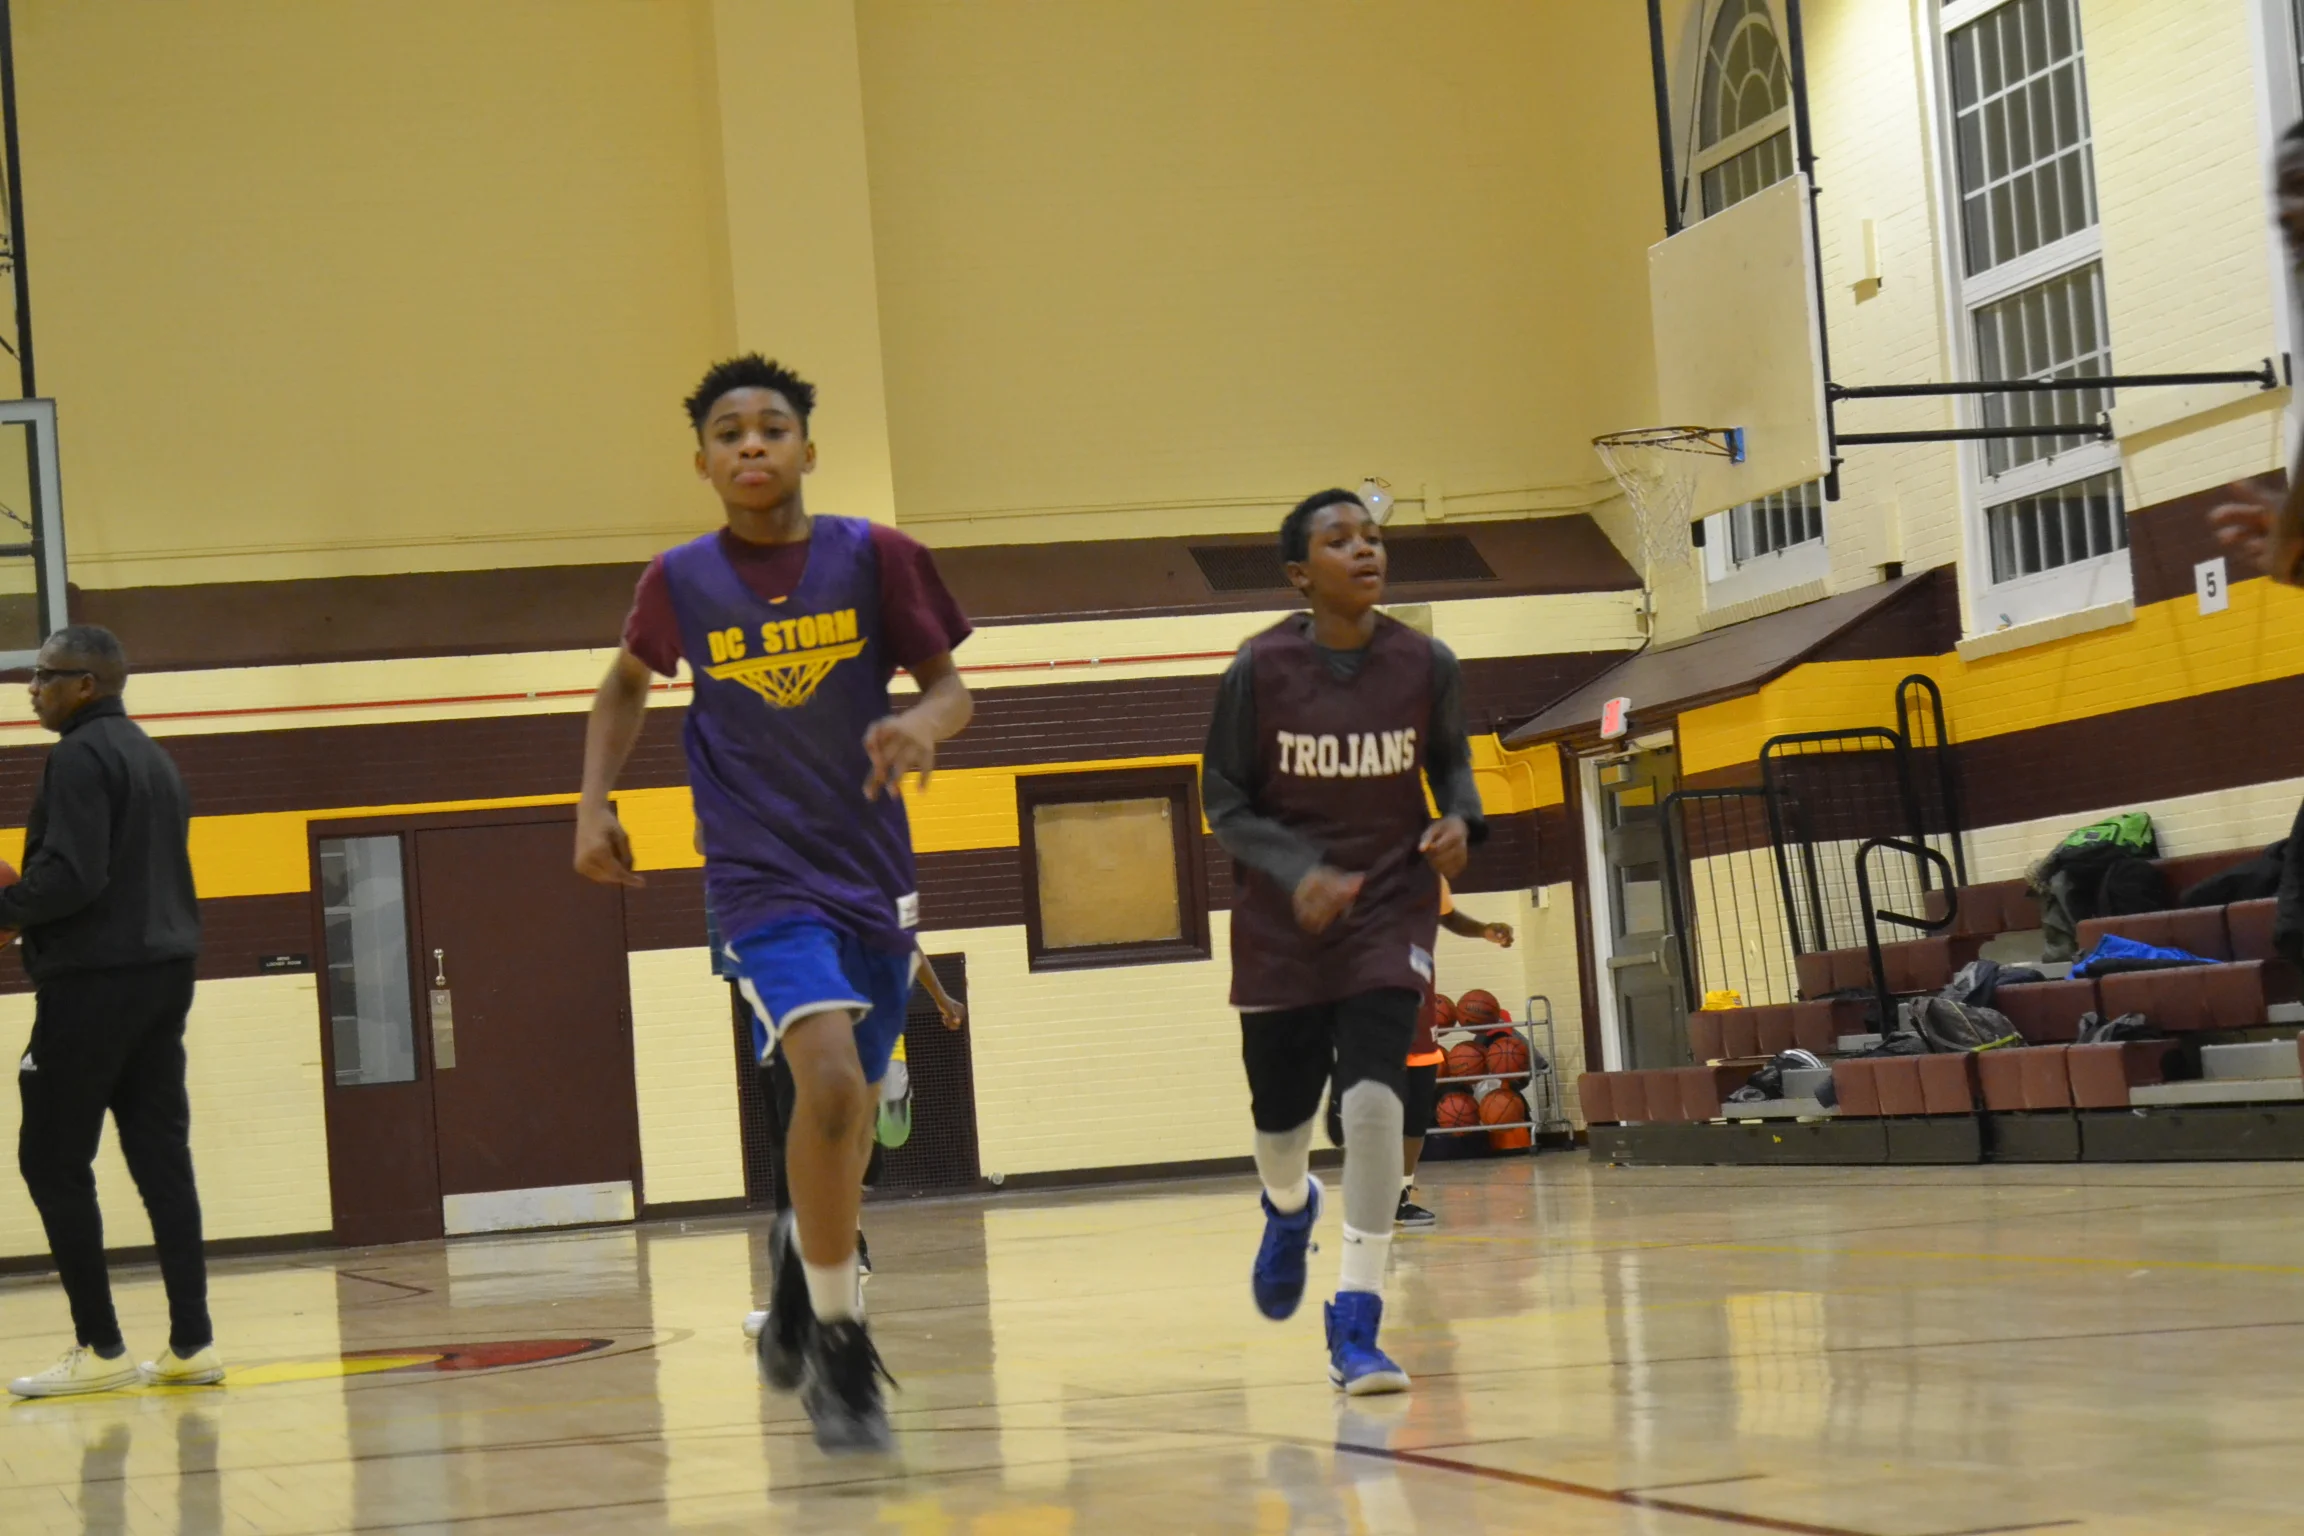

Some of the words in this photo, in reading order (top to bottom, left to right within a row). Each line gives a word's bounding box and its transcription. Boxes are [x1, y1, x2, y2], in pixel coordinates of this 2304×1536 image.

[2205, 571, 2217, 598] 5
[707, 626, 747, 664] DC
[761, 608, 858, 654] STORM
[1276, 727, 1416, 778] TROJANS
